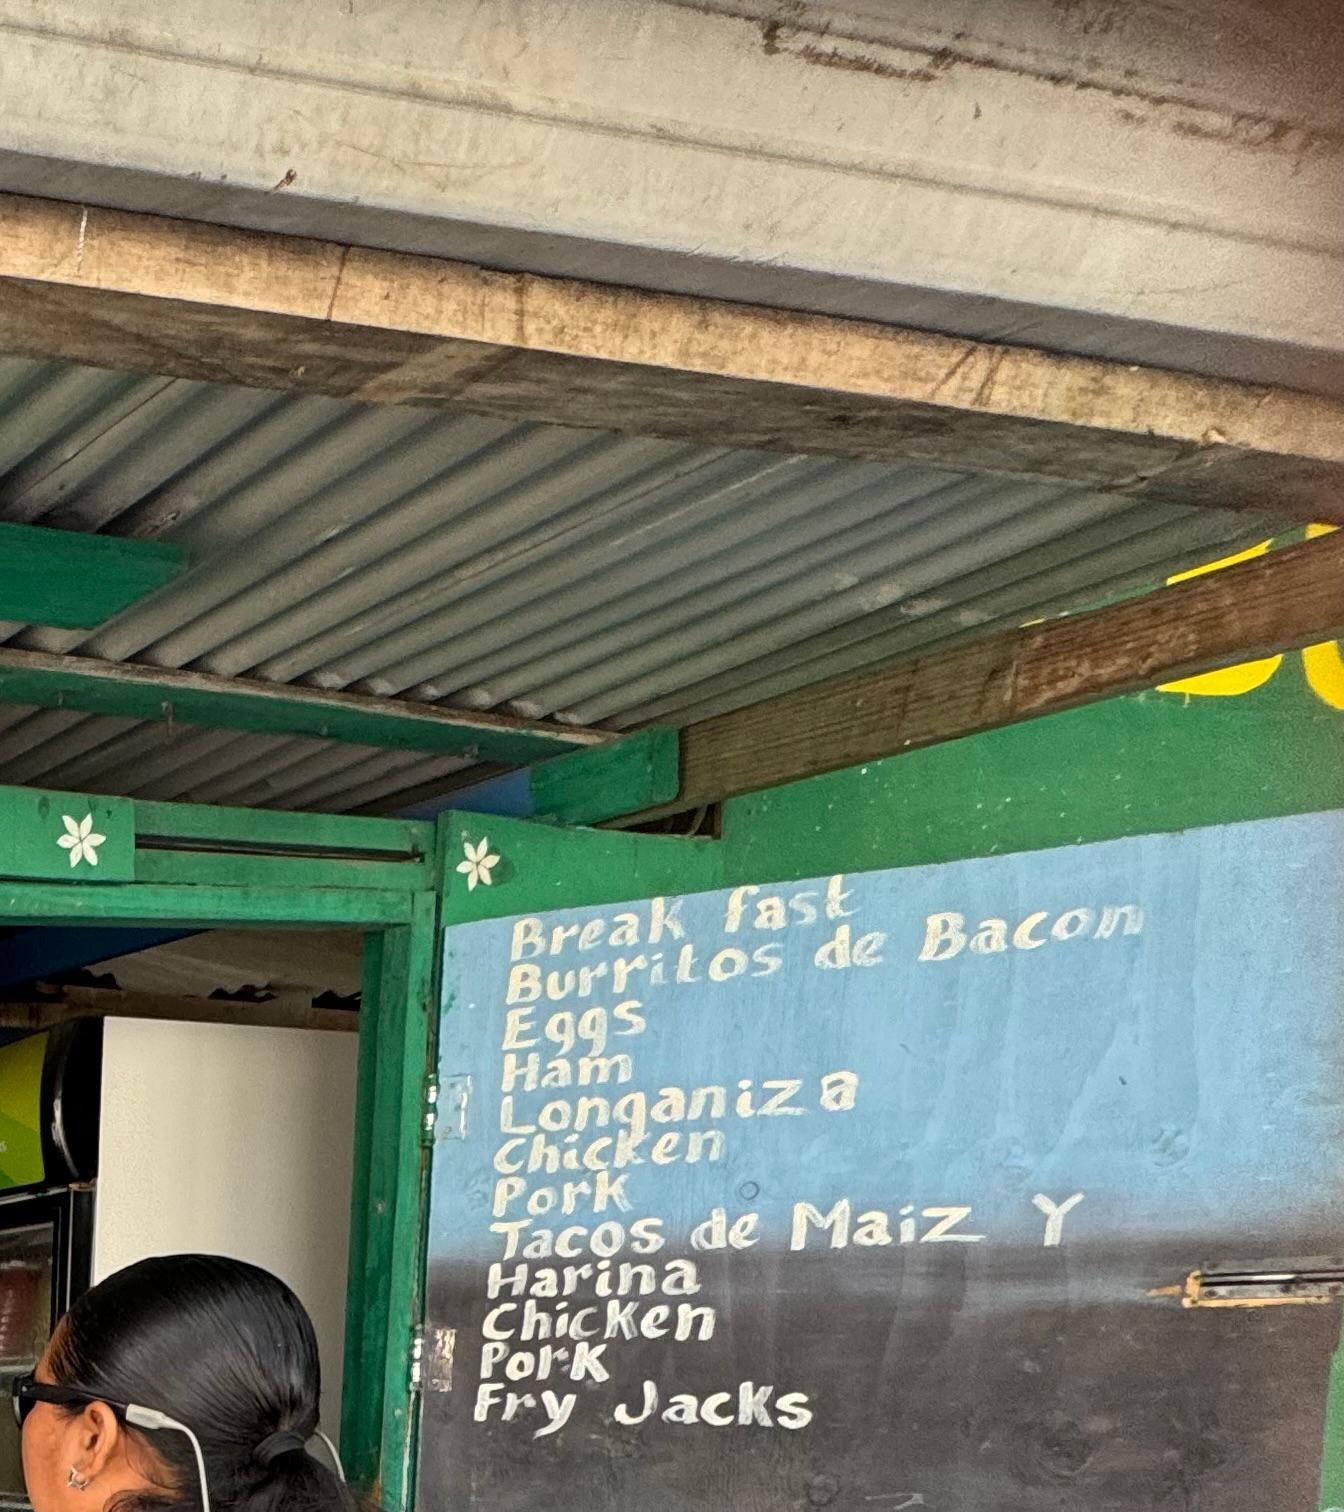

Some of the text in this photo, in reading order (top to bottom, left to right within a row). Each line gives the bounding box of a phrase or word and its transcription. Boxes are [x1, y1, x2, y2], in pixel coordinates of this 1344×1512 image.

[814, 923, 888, 970] de
[916, 904, 1145, 962] Bacon
[502, 999, 647, 1058] Eggs
[501, 1052, 634, 1093] Ham
[489, 1192, 1085, 1261] Tacos de Maiz Y
[486, 1259, 702, 1300] Harina
[473, 1382, 577, 1440] Fry
